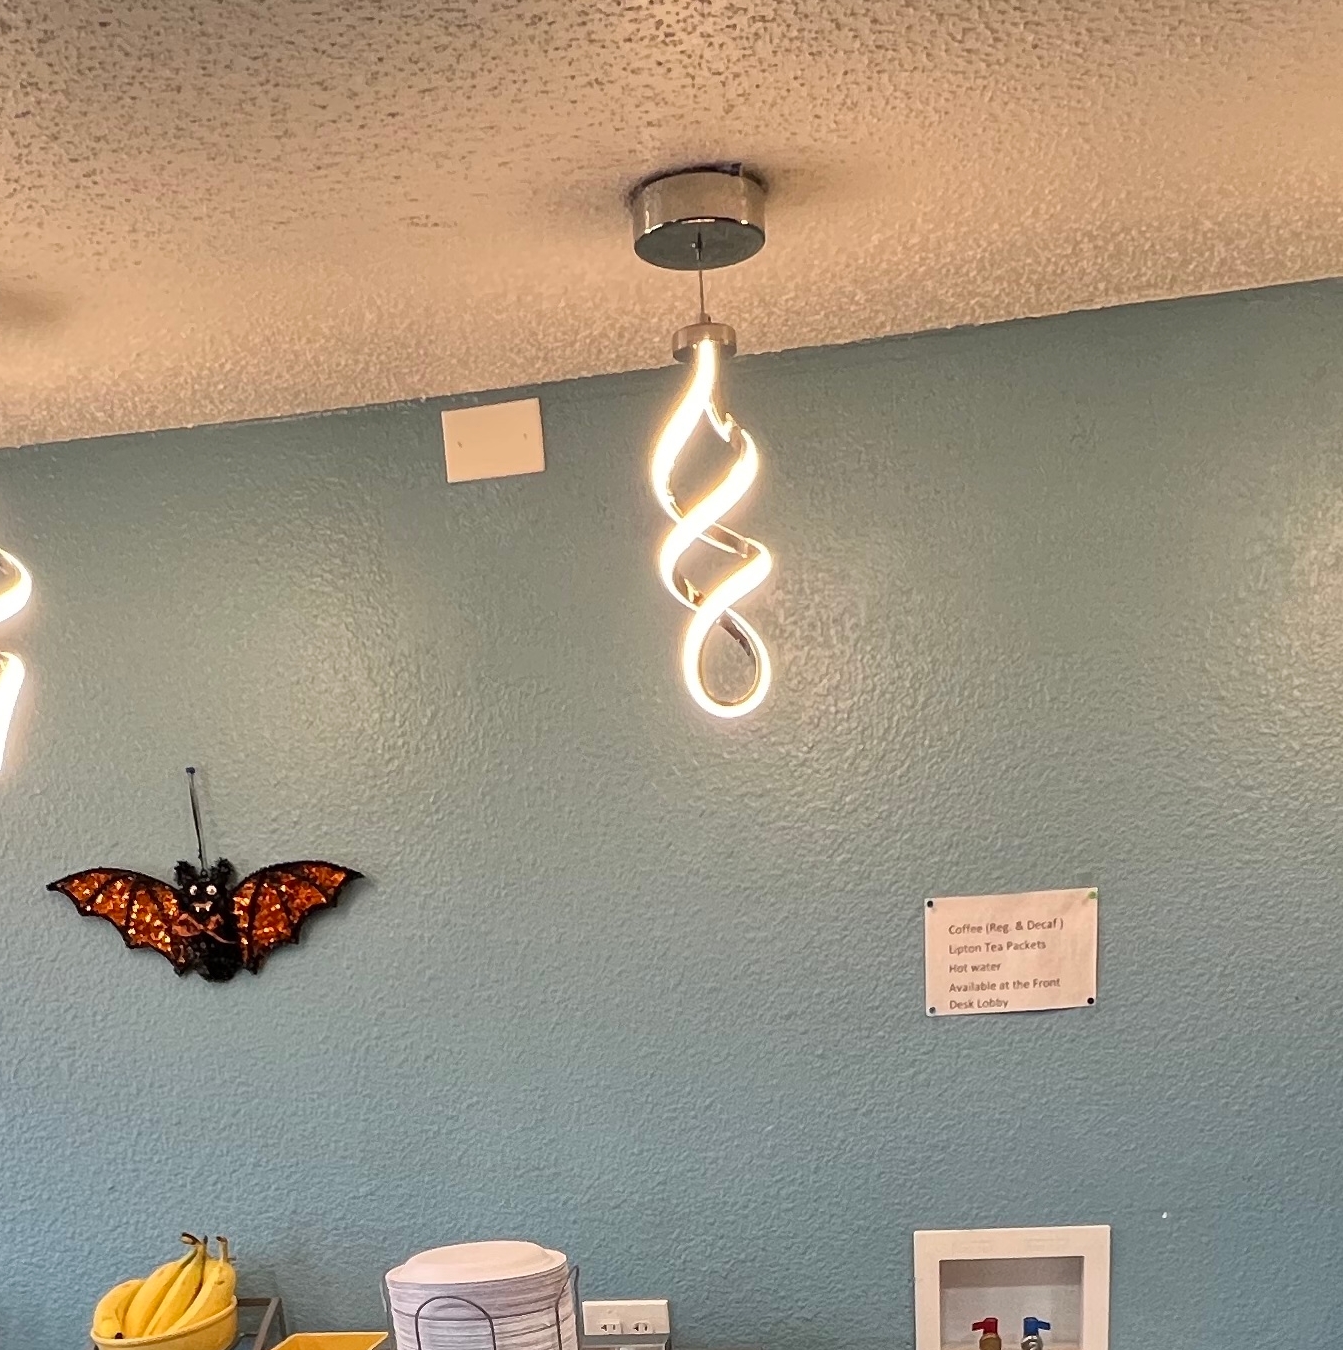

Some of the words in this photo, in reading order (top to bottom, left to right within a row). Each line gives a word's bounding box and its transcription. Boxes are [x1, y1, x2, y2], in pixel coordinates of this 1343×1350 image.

[948, 923, 983, 936] Coffee
[1015, 920, 1024, 931] &
[1026, 917, 1058, 931] Decaf
[948, 942, 982, 956] Lipton
[984, 941, 1004, 952] Tea
[1006, 939, 1047, 952] Packets
[948, 962, 968, 974] Hot
[971, 962, 1001, 973] water
[948, 979, 997, 994] Available
[998, 980, 1010, 991] at
[1012, 979, 1030, 990] the
[1032, 977, 1061, 989] Front
[949, 999, 975, 1010] Desk
[977, 997, 1009, 1010] Lobby
